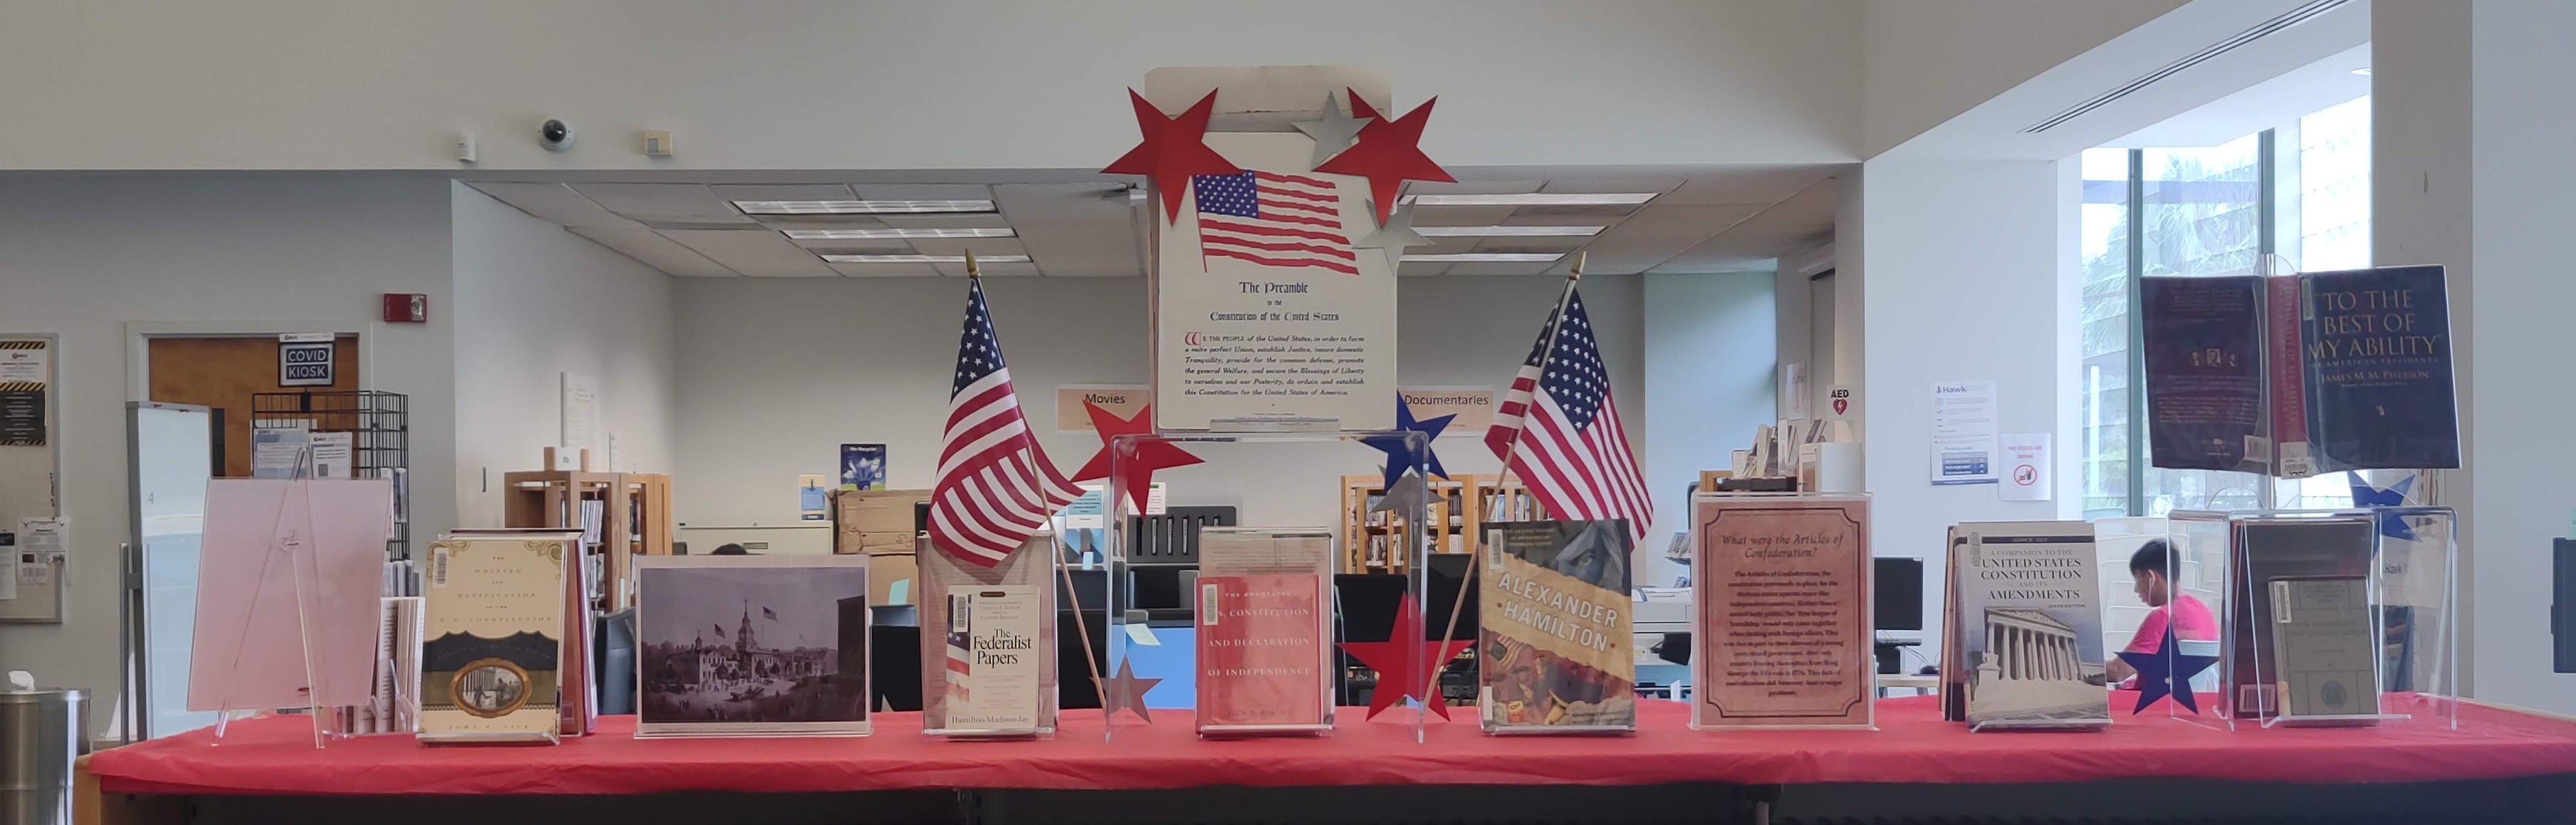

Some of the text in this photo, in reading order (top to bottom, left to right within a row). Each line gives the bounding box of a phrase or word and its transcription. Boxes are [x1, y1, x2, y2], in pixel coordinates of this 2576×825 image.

[1239, 281, 1308, 294] The Preamble
[2364, 289, 2414, 309] THE
[1210, 311, 1339, 323] Constitution of the United States
[2324, 313, 2415, 335] BEST OF
[2308, 339, 2340, 360] MY
[288, 350, 326, 361] COVID
[2326, 358, 2377, 367] AMERICAN
[288, 365, 325, 378] KIOSK
[1085, 393, 1126, 404] Movies
[1830, 390, 1850, 398] AED
[1404, 395, 1488, 405] Documentaries
[1722, 534, 1746, 545] What
[1775, 534, 1789, 544] the
[1793, 534, 1830, 545] Articles
[1833, 534, 1843, 547] of
[1745, 546, 1818, 562] Confederation?
[1982, 558, 2081, 569] UNITED STATES
[1981, 570, 2082, 580] CONSTITUTION
[1988, 589, 2080, 600] AMENDMENTS
[1498, 573, 1618, 628] ALEXANDER
[1229, 608, 1309, 617] CONSTITUTION
[1503, 600, 1608, 652] HAMILTON
[994, 628, 1011, 638] The
[974, 635, 1032, 650] Federalist
[1234, 638, 1310, 647] DECLARATION
[977, 650, 1018, 668] Papers
[1226, 667, 1310, 677] INDEPENDENCE
